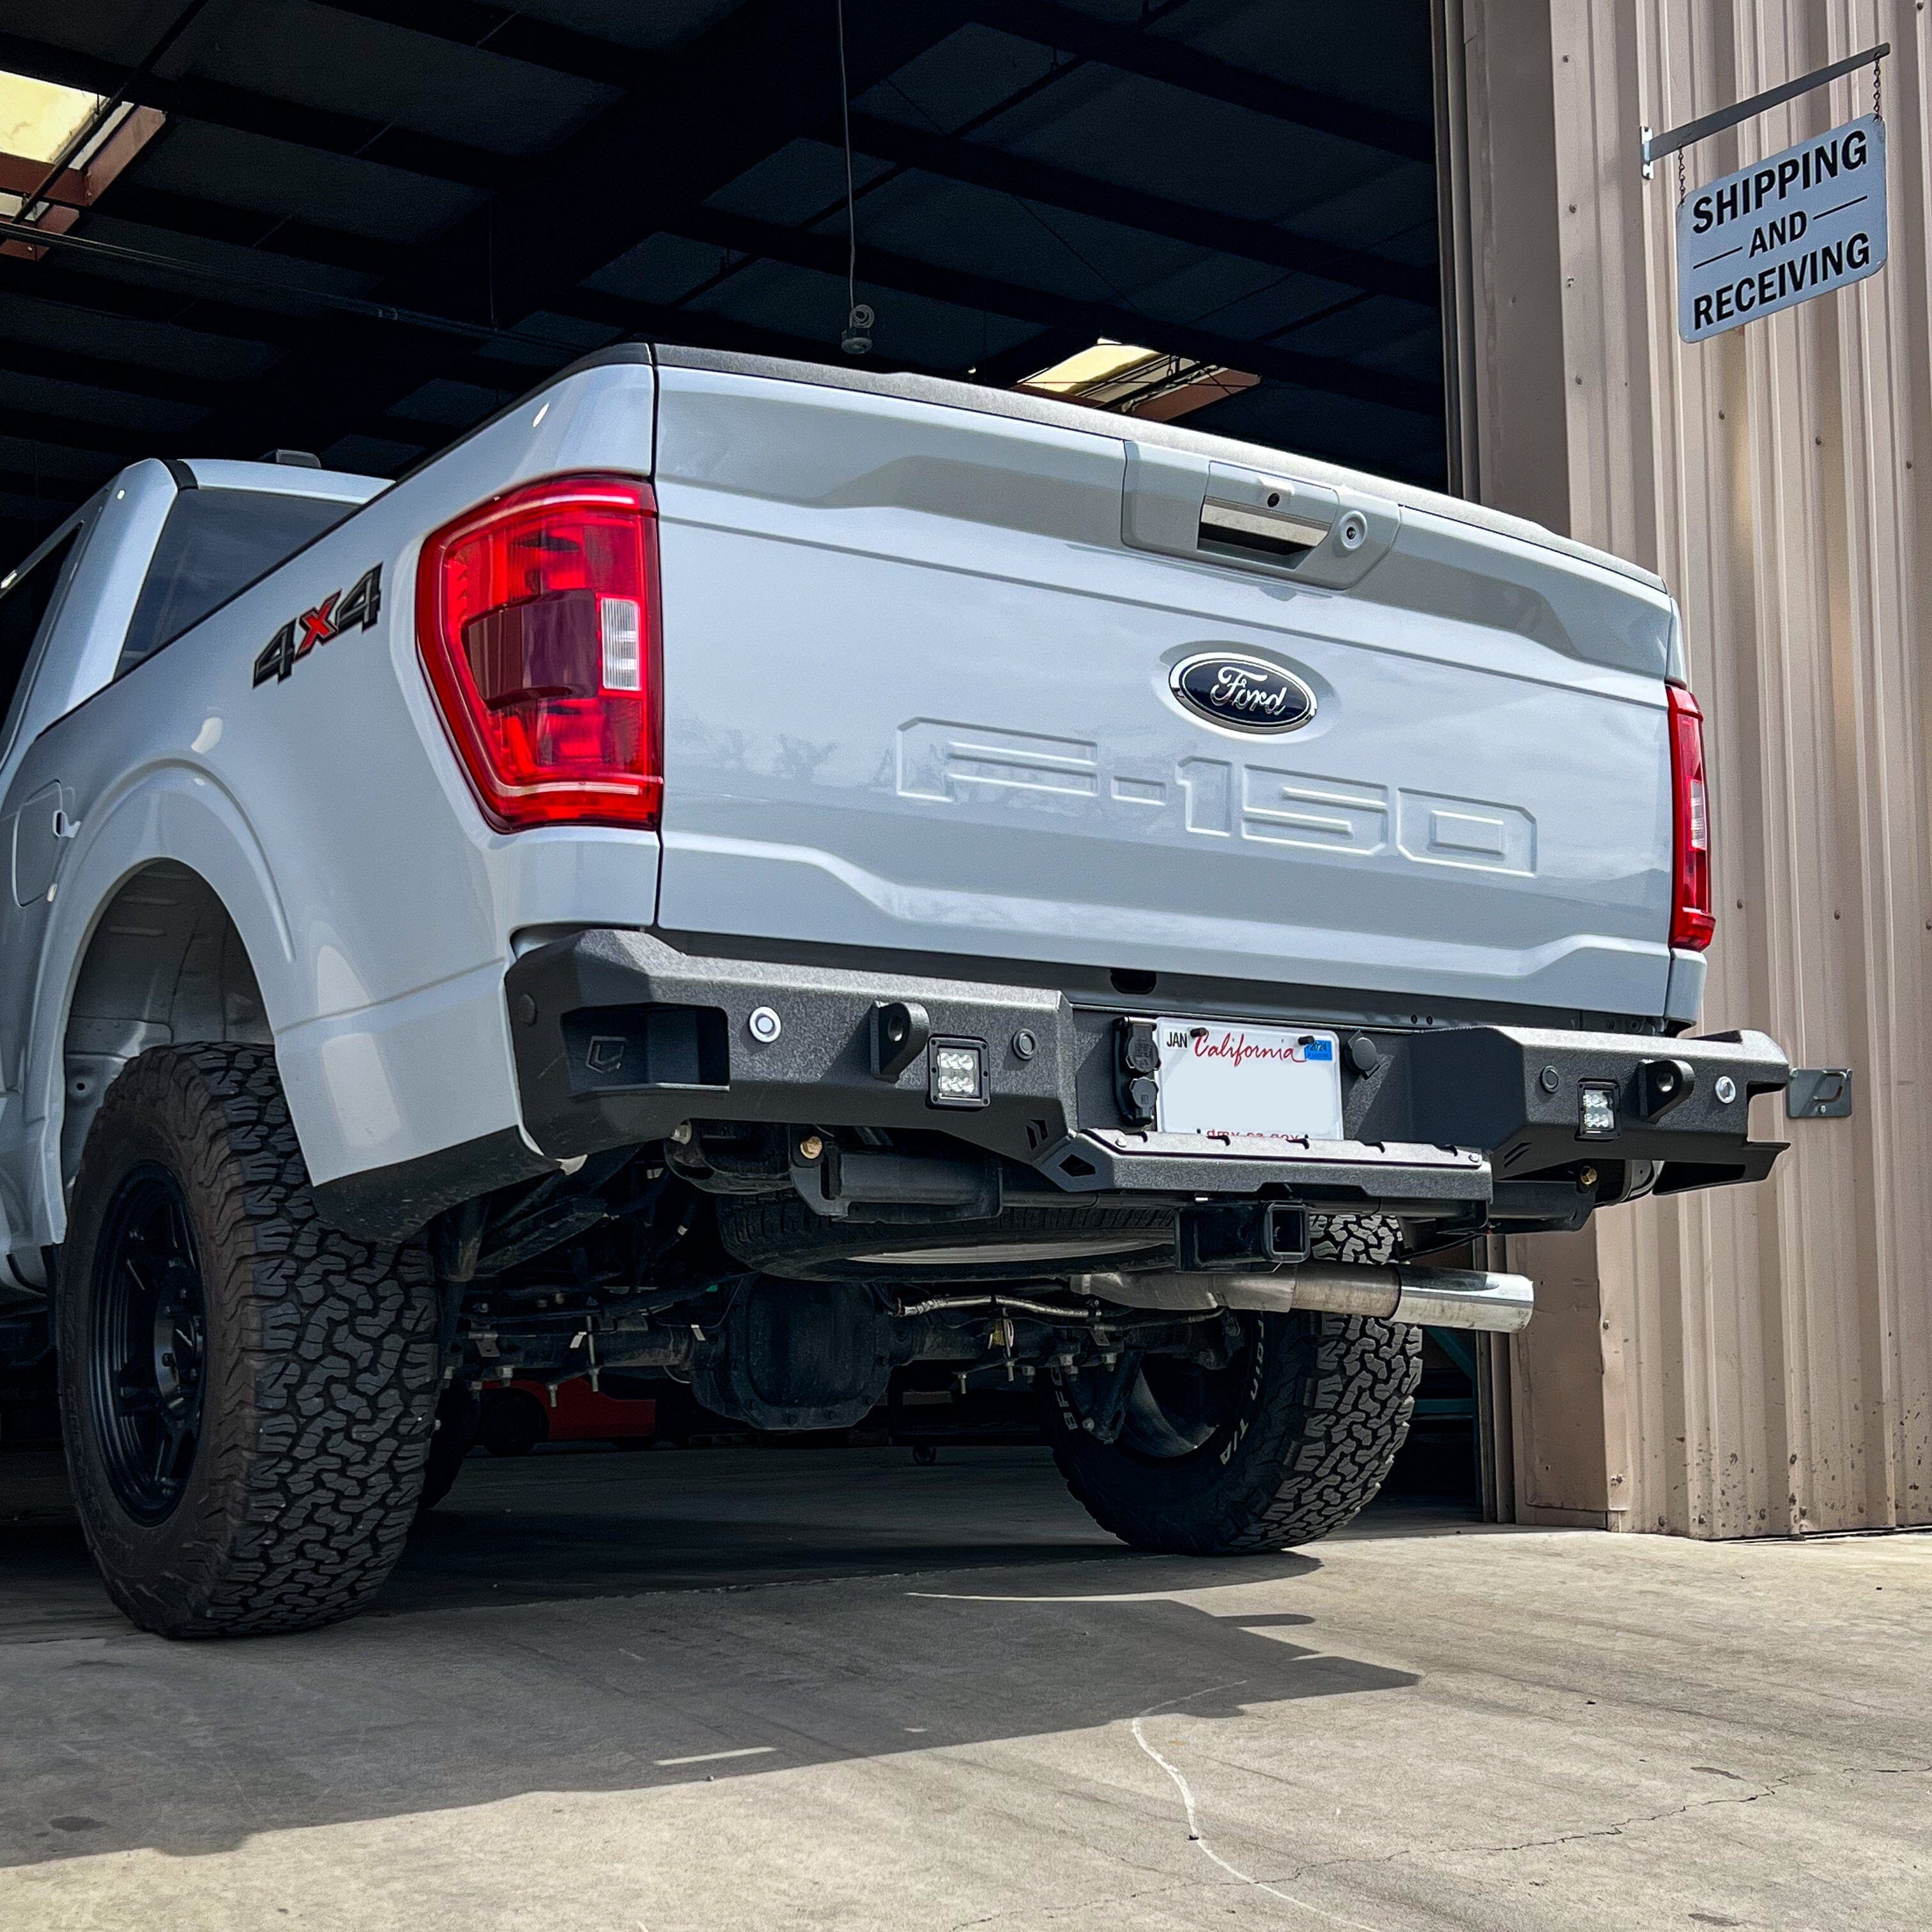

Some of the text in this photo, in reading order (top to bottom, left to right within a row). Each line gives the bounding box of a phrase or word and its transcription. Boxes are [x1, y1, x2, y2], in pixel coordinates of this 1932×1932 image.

[1692, 130, 1867, 234] SHIPPING
[1749, 211, 1807, 259] AND
[1694, 232, 1870, 330] RECEIVING
[1210, 666, 1287, 715] Ford
[898, 716, 1536, 878] F-150
[1166, 1032, 1188, 1048] JAN
[1193, 1031, 1307, 1067] California
